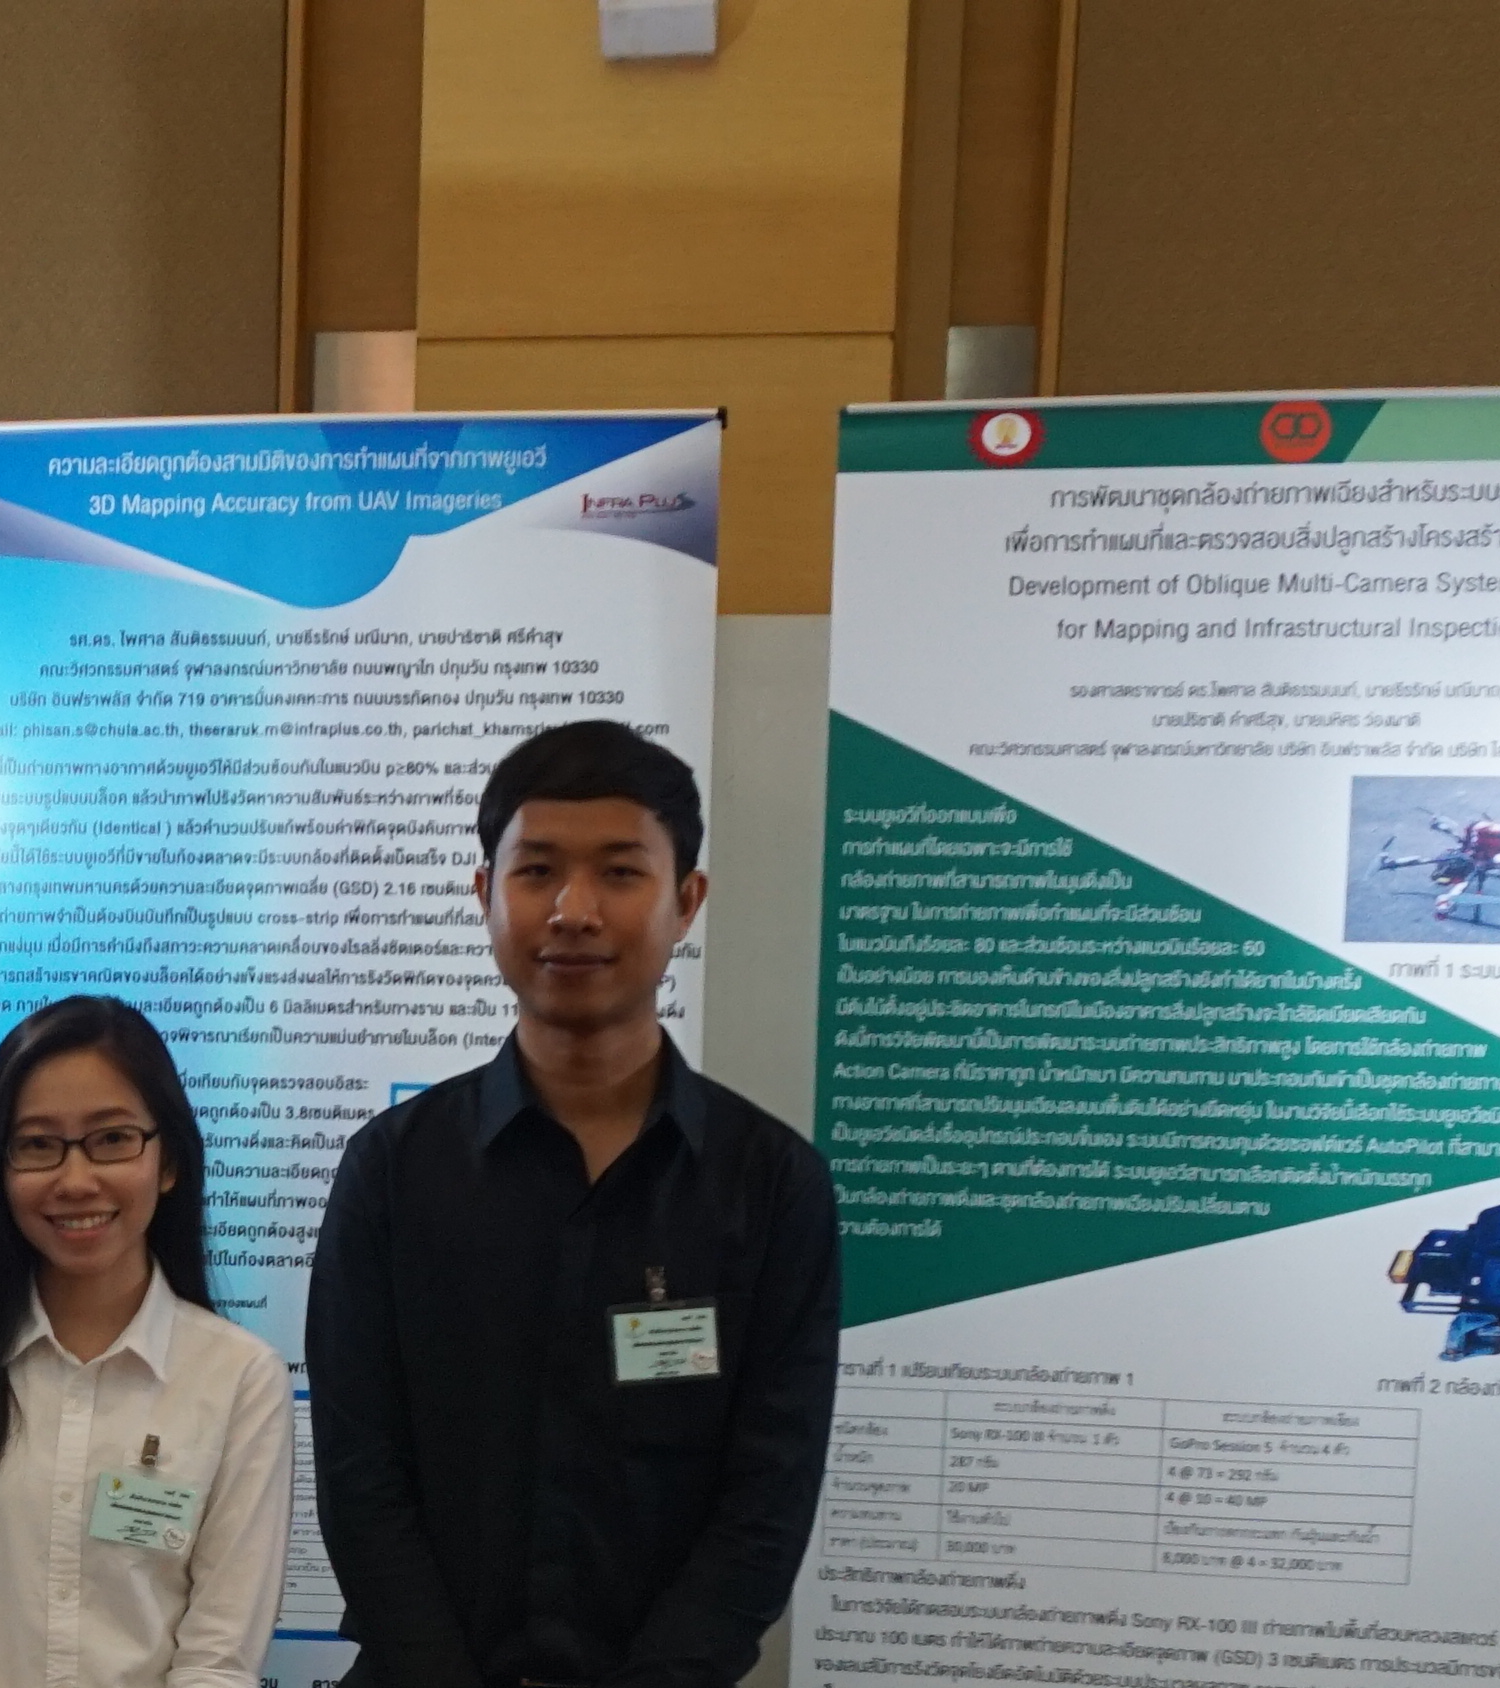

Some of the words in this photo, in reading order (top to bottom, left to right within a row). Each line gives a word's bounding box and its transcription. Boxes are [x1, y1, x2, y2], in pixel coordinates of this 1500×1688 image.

[89, 494, 116, 515] 3D
[122, 493, 206, 518] Mapping
[212, 491, 300, 517] Accuracy
[305, 490, 352, 512] from
[358, 490, 399, 511] UAV
[406, 488, 503, 515] Imageries
[1008, 573, 1150, 601] Development
[1157, 574, 1180, 595] of
[1187, 571, 1271, 599] Oblique
[1278, 571, 1429, 595] Multi-Camera
[1056, 619, 1088, 641] for
[1094, 618, 1190, 644] Mapping
[1196, 618, 1238, 640] and
[1244, 616, 1402, 640] Infrastructural
[553, 659, 599, 676] 10330
[178, 691, 205, 707] 719
[578, 689, 625, 706] 10330
[1430, 1378, 1441, 1395] 2
